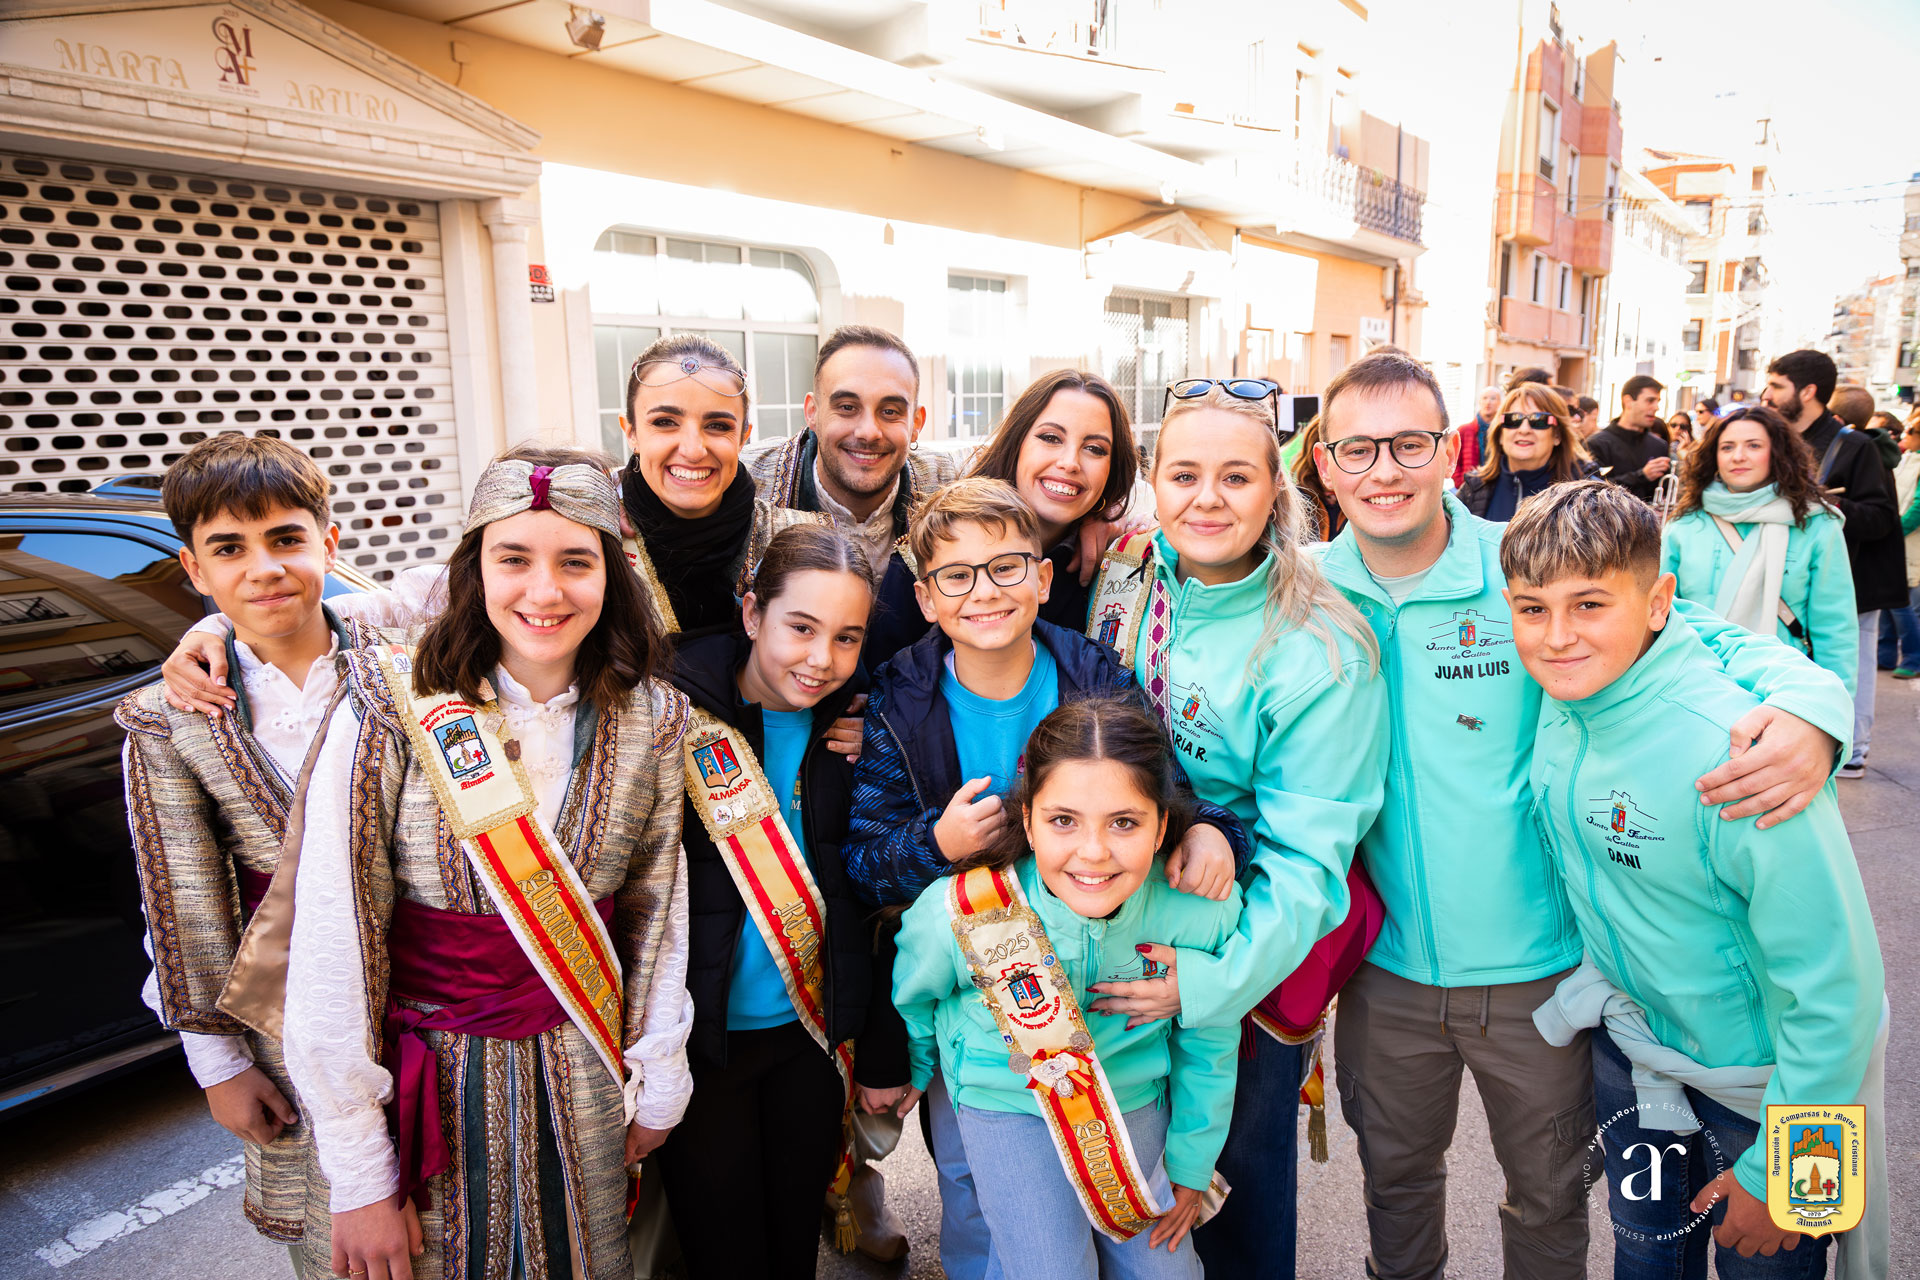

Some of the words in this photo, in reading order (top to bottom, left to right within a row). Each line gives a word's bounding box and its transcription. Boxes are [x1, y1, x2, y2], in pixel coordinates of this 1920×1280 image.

[53, 38, 191, 90] MARTA
[284, 79, 399, 123] ARTURO
[1104, 577, 1139, 595] 2025
[1435, 665, 1473, 679] JUAN
[1478, 660, 1510, 678] LUIS
[1195, 746, 1208, 762] R.
[708, 778, 752, 800] ALMANSA
[1608, 847, 1642, 870] DANI
[516, 869, 604, 1001] Abanderada
[984, 932, 1029, 965] 2025
[1019, 1003, 1052, 1018] ALMANSA
